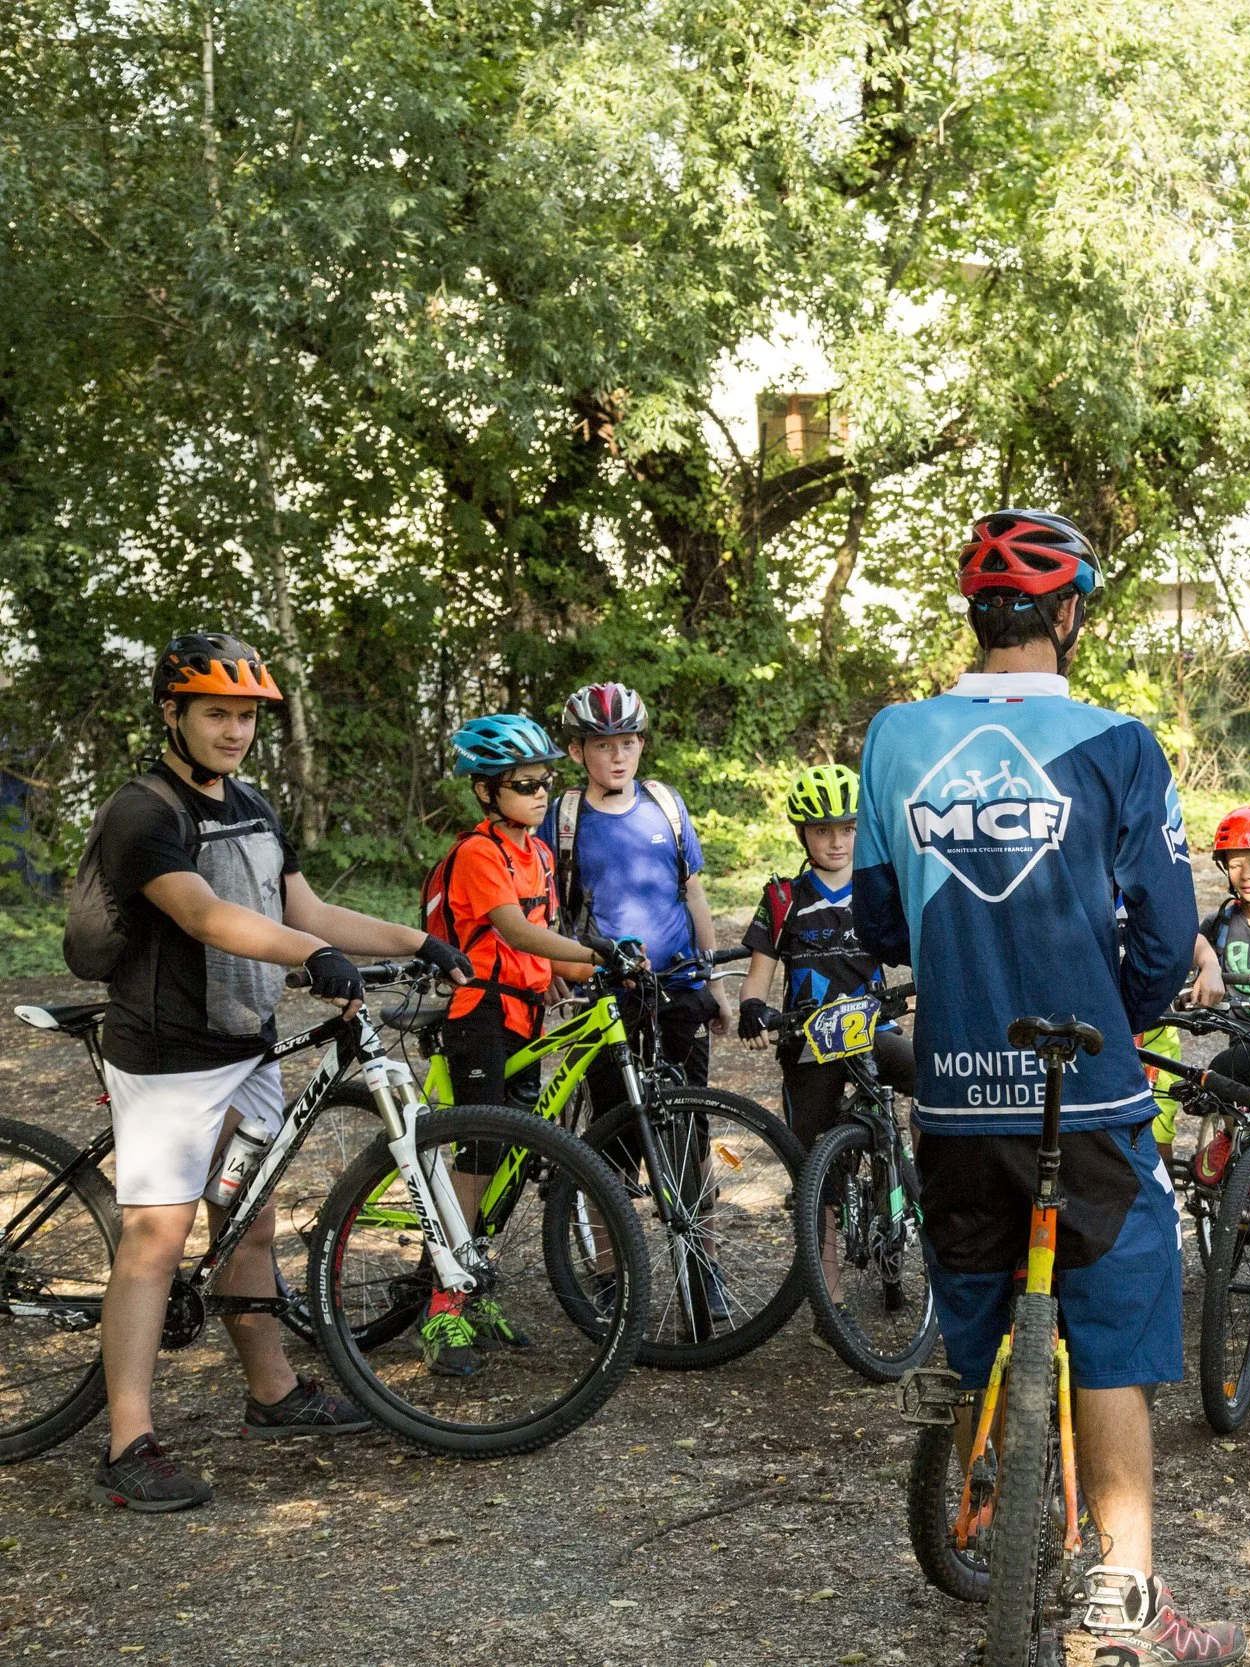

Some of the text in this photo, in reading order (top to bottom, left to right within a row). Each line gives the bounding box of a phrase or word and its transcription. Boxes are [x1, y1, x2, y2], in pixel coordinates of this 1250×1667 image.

[912, 802, 1060, 841] MCF
[840, 1000, 869, 1014] BIKER
[274, 1030, 311, 1055] ULTRA
[841, 1011, 870, 1051] 2
[293, 1067, 333, 1131] KTM
[967, 1083, 1047, 1106] GUIDE
[227, 1157, 250, 1177] IA
[319, 1228, 336, 1326] SCHWALBE
[601, 1317, 626, 1372] RAPID
